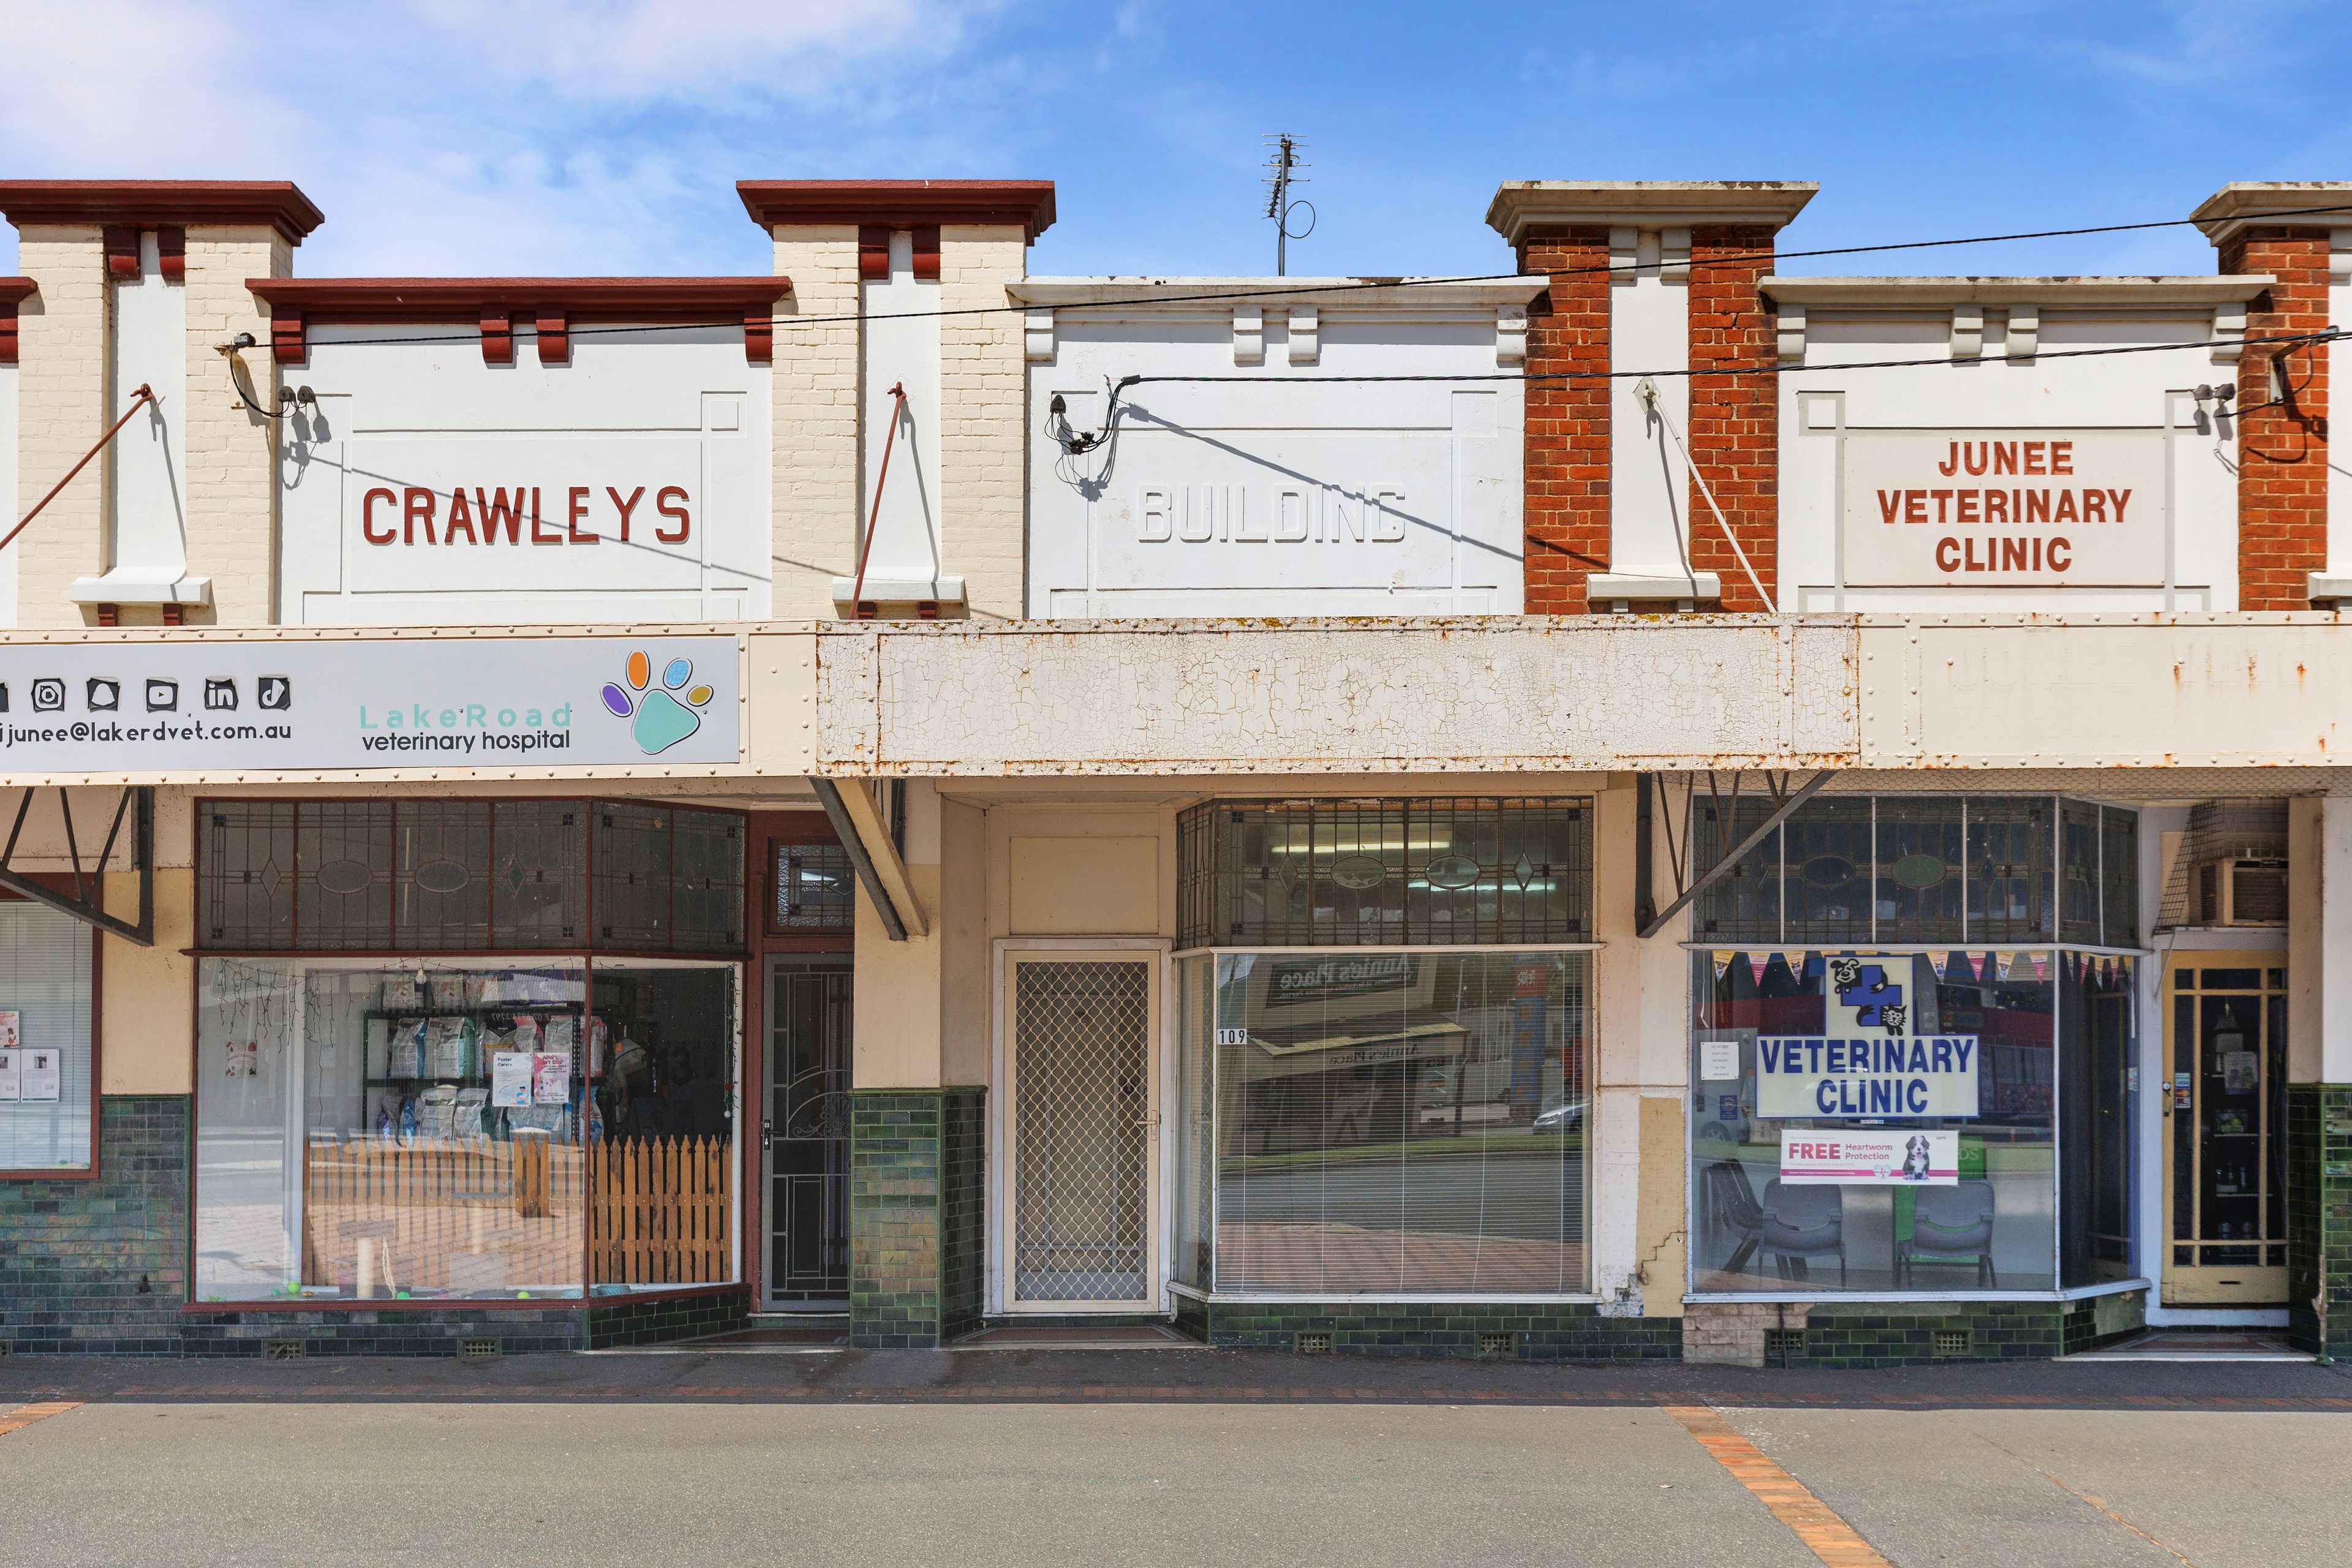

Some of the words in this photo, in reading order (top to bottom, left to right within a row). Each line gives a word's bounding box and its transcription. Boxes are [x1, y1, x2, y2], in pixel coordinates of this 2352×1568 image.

[1939, 442, 2073, 477] JUNEE
[363, 486, 690, 545] CRAWLEYS
[1138, 484, 1406, 543] BUILDING
[1877, 489, 2132, 523] VETERINARY
[1936, 537, 2072, 572] CLINIC
[362, 731, 476, 753] veterinary
[482, 730, 570, 753] hospital
[1219, 1030, 1245, 1044] 109
[1760, 1039, 1975, 1074] VETERINARY
[1816, 1079, 1928, 1114] CLINIC
[1789, 1143, 1841, 1159] FREE
